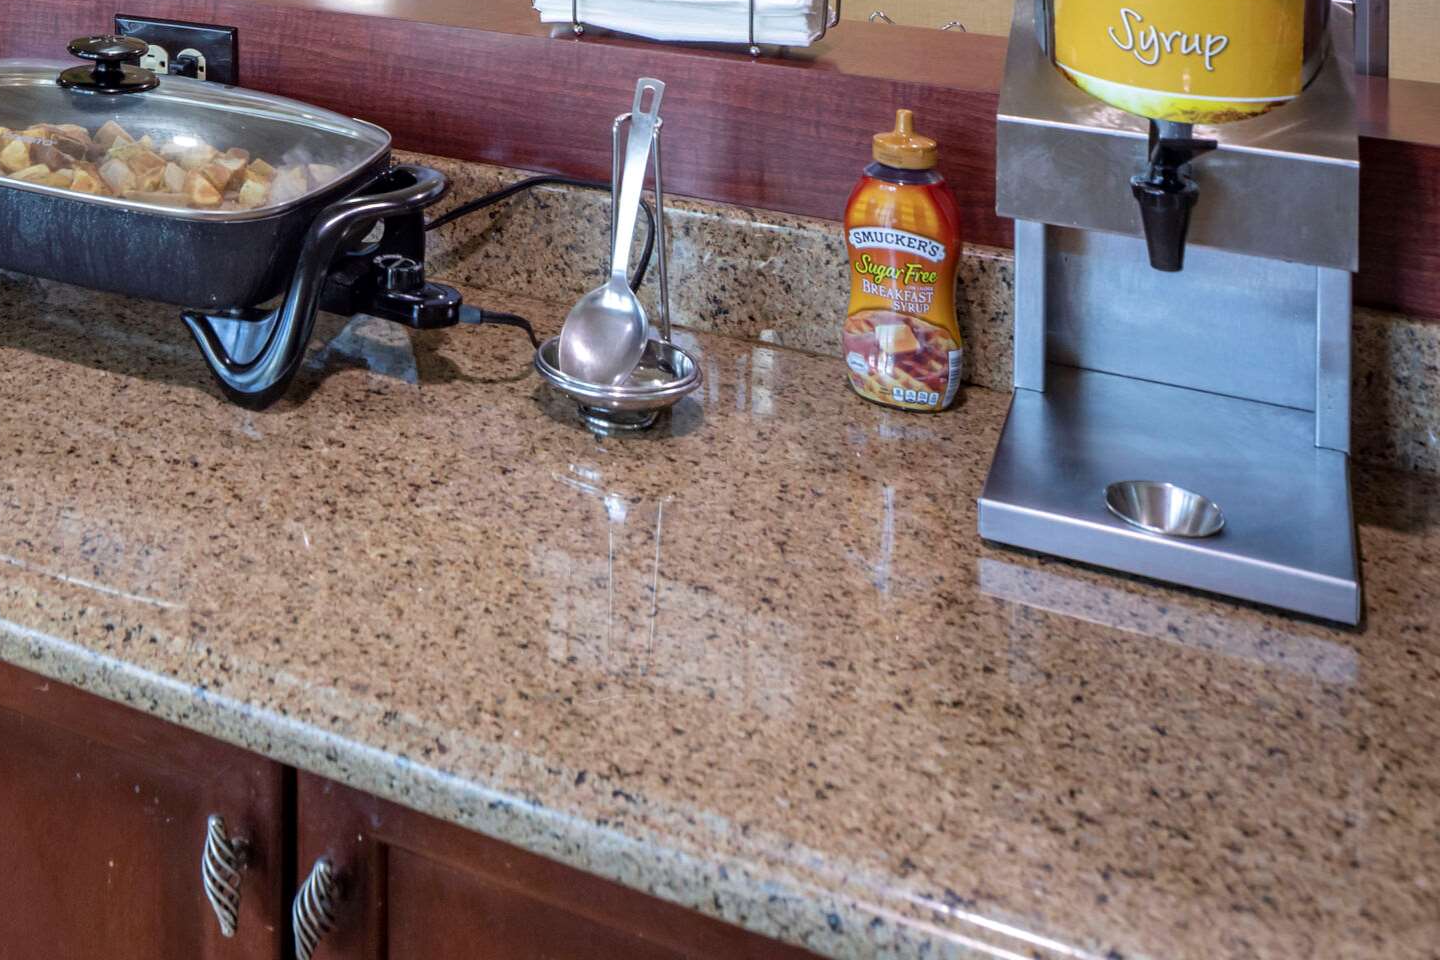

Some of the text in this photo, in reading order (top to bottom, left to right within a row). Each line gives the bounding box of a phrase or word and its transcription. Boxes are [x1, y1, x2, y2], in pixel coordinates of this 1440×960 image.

[1108, 8, 1229, 71] Syrup
[853, 231, 940, 257] SMUCKER'S
[855, 254, 937, 285] Sugar Free
[862, 278, 934, 303] BREAKFAST
[893, 300, 930, 313] SYRUP
